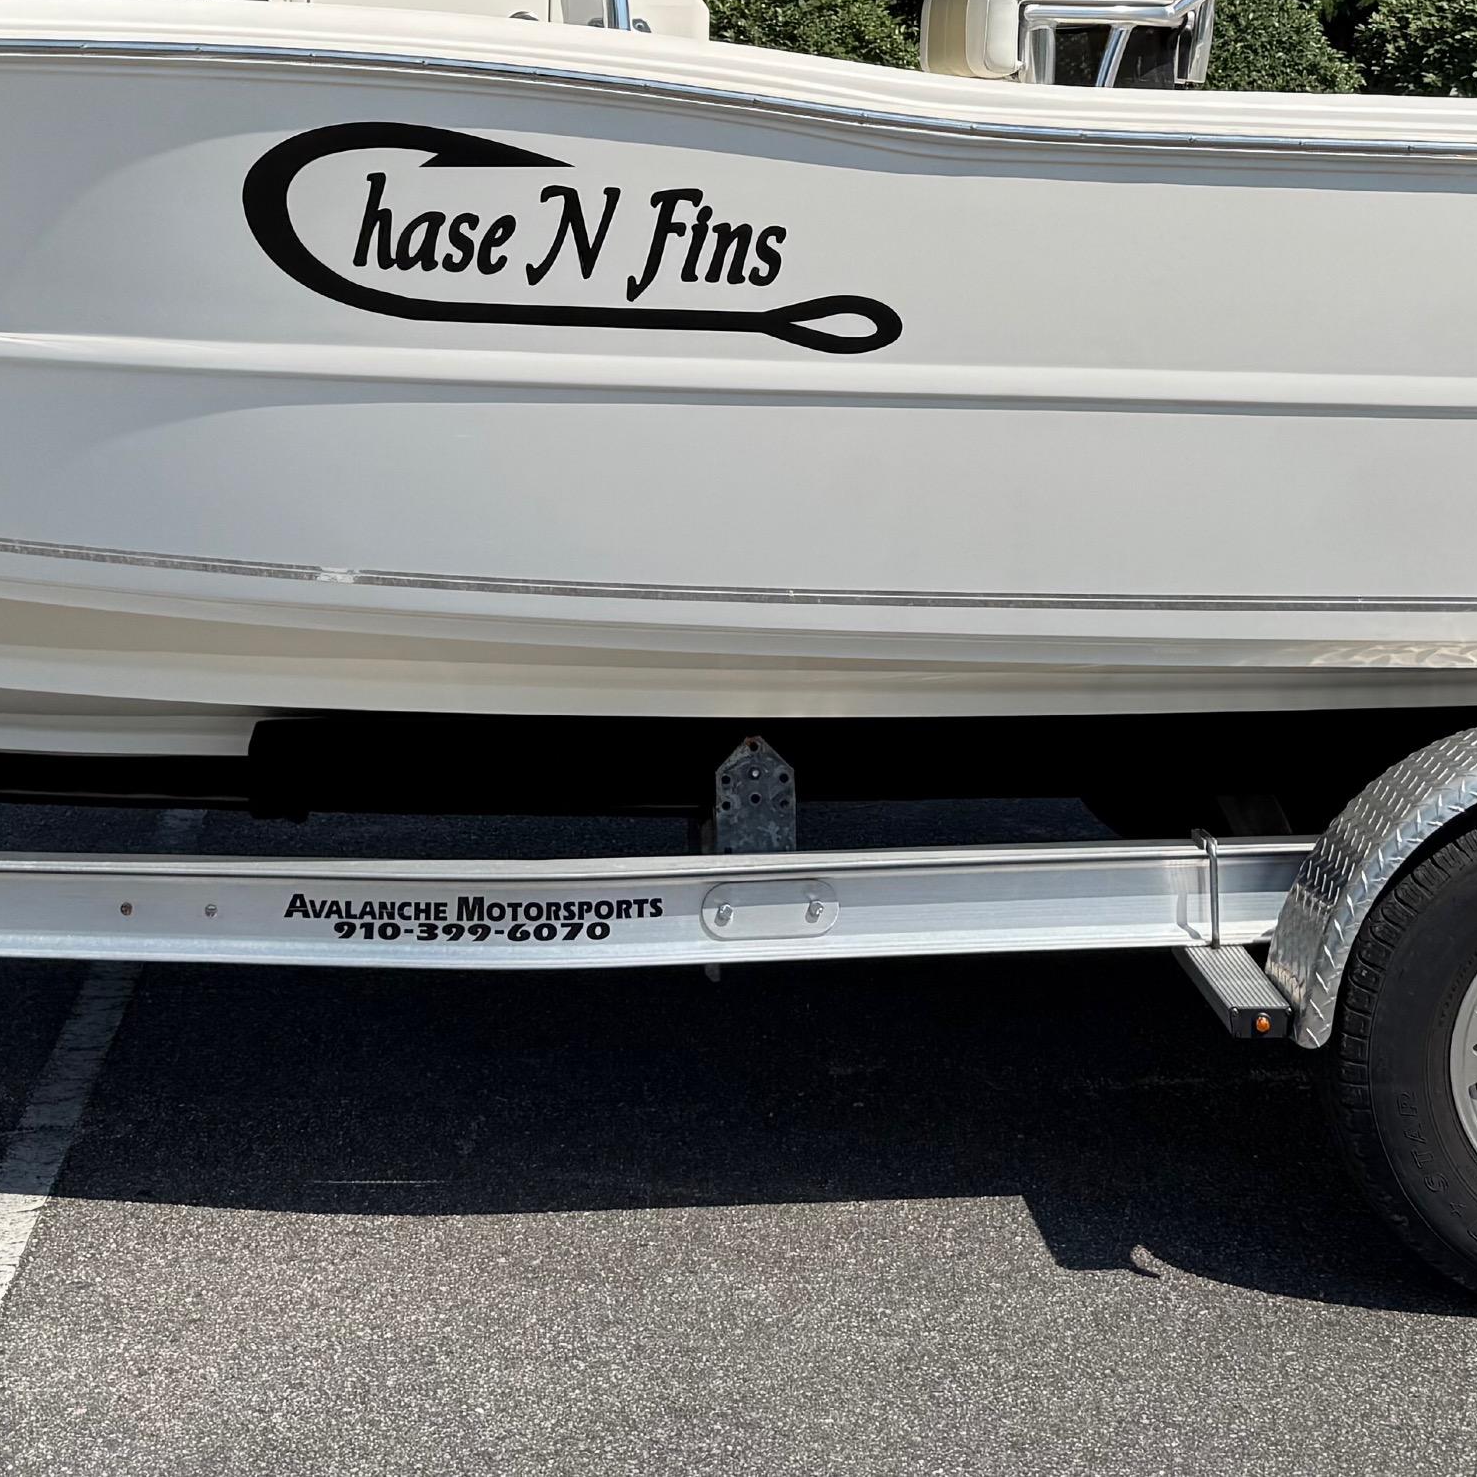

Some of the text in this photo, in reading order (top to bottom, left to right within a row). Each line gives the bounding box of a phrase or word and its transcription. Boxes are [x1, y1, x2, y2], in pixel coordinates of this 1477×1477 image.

[526, 184, 621, 286] N
[626, 187, 787, 302] Fins
[283, 893, 664, 922] AVALANCHE MOTORSPORTS
[333, 922, 612, 942] 910-399-6070
